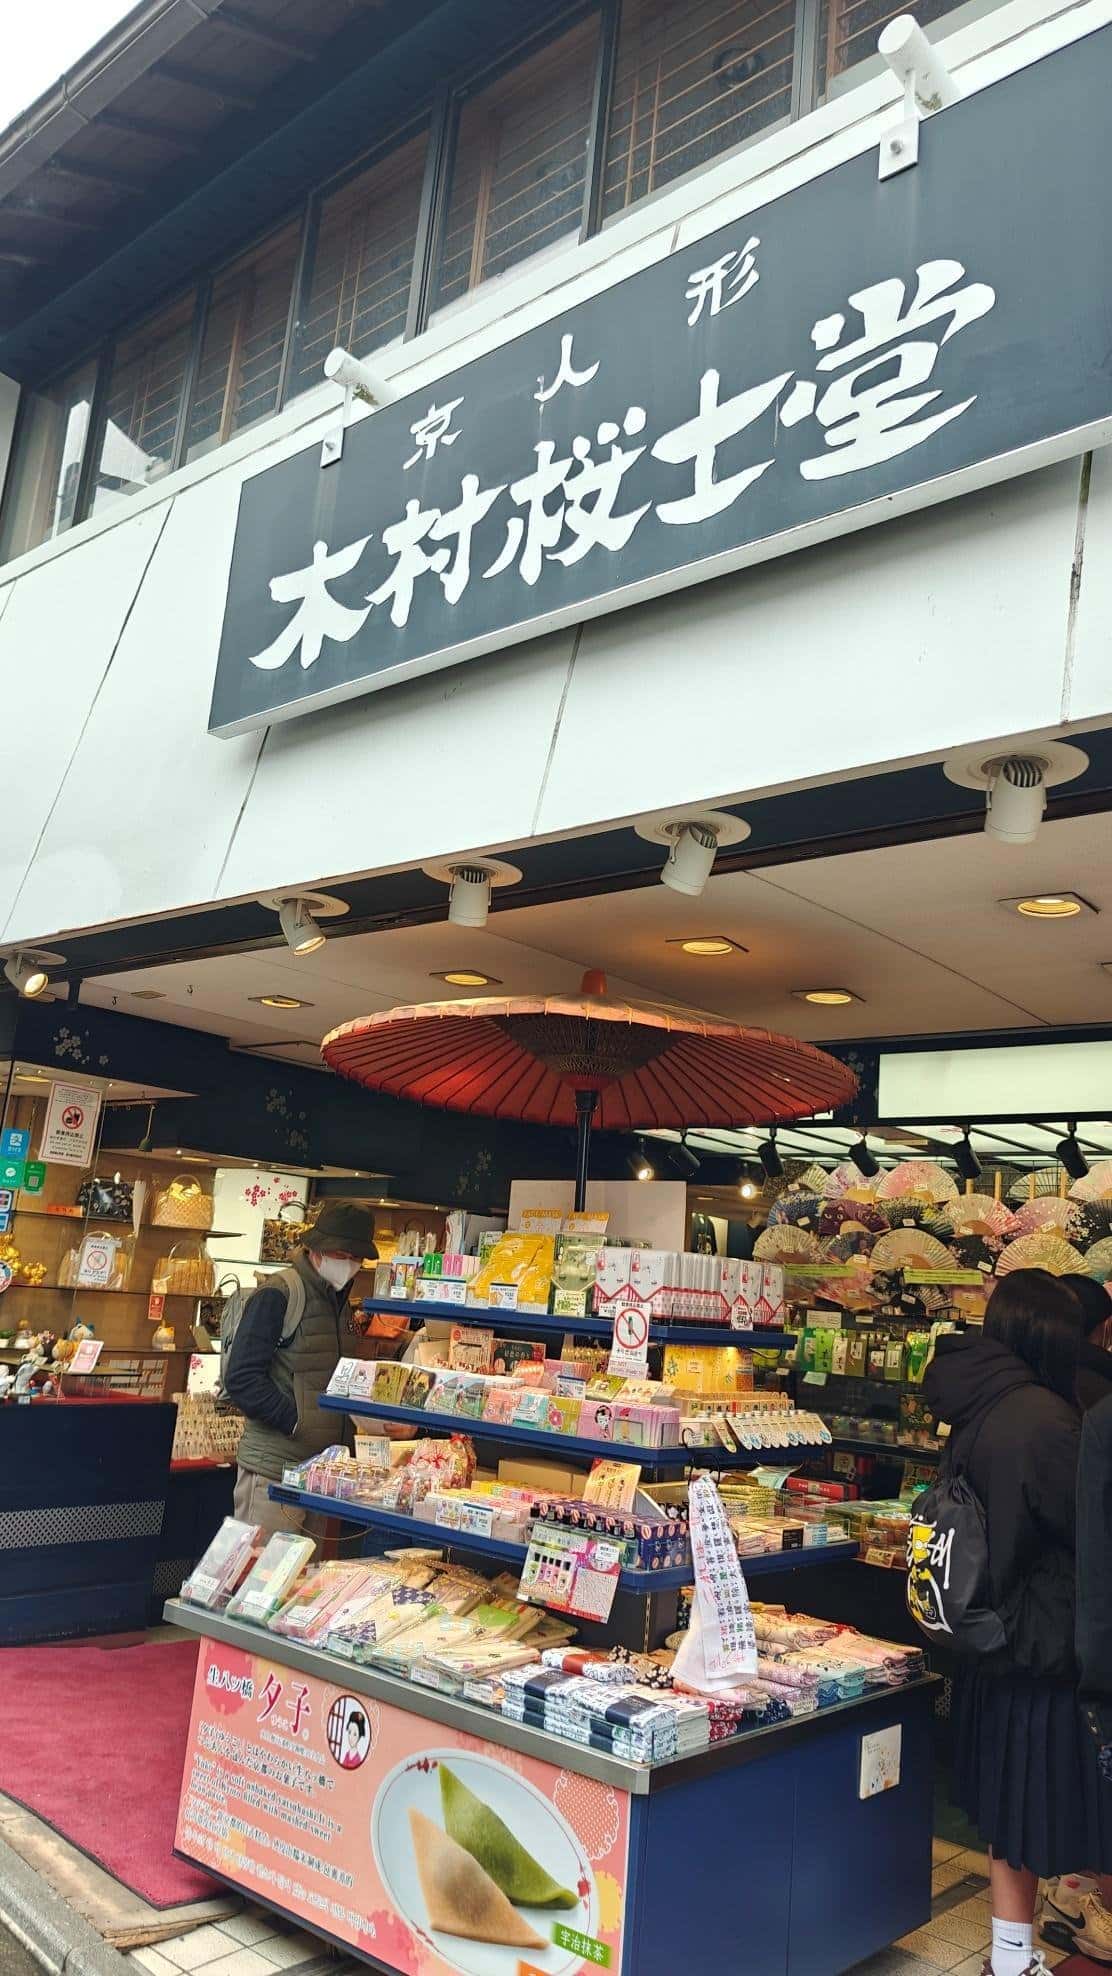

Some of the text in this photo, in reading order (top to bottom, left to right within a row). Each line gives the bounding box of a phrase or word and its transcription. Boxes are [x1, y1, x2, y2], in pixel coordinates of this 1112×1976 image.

[256, 1671, 312, 1735] 夕子
[231, 1776, 245, 1788] soft
[263, 1801, 278, 1816] with
[280, 1811, 308, 1830] mashed
[310, 1825, 331, 1841] sweet
[560, 1929, 604, 1962] 宇治抹茶
